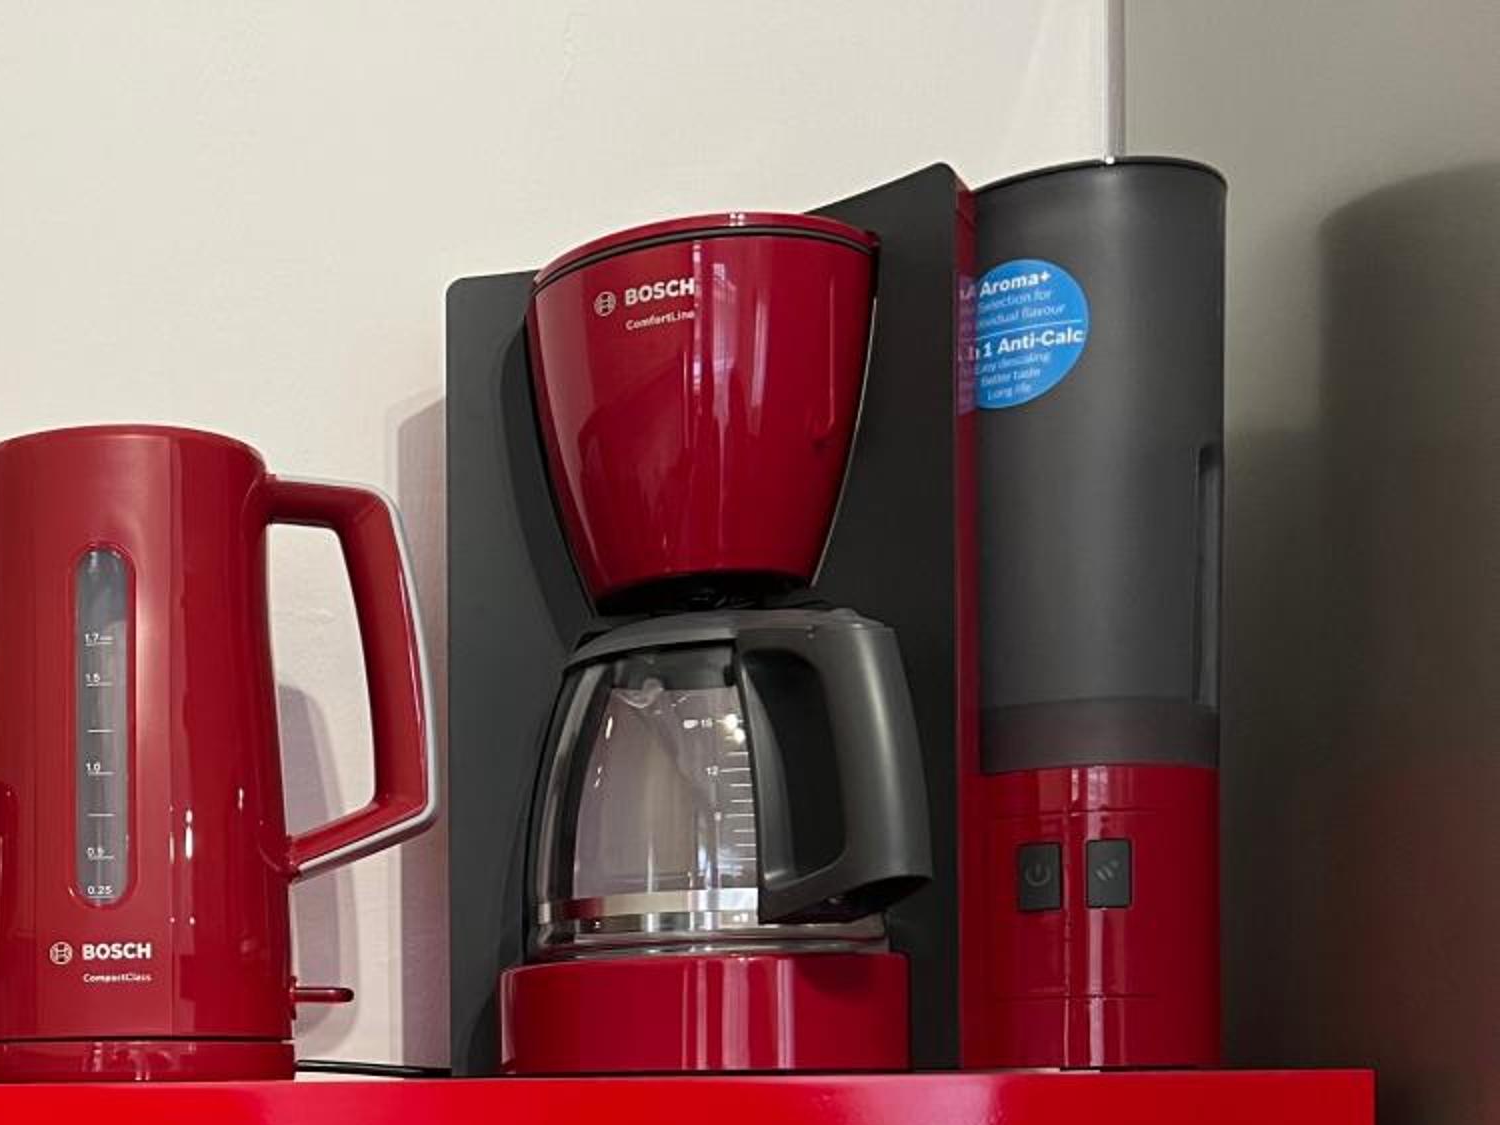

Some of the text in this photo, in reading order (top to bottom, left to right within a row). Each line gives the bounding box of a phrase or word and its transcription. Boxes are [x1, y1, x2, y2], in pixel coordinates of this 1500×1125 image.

[625, 278, 695, 306] BOSCH
[979, 269, 1051, 297] Aroma+
[997, 326, 1085, 354] Anti-Calc
[82, 942, 152, 960] BOSCH
